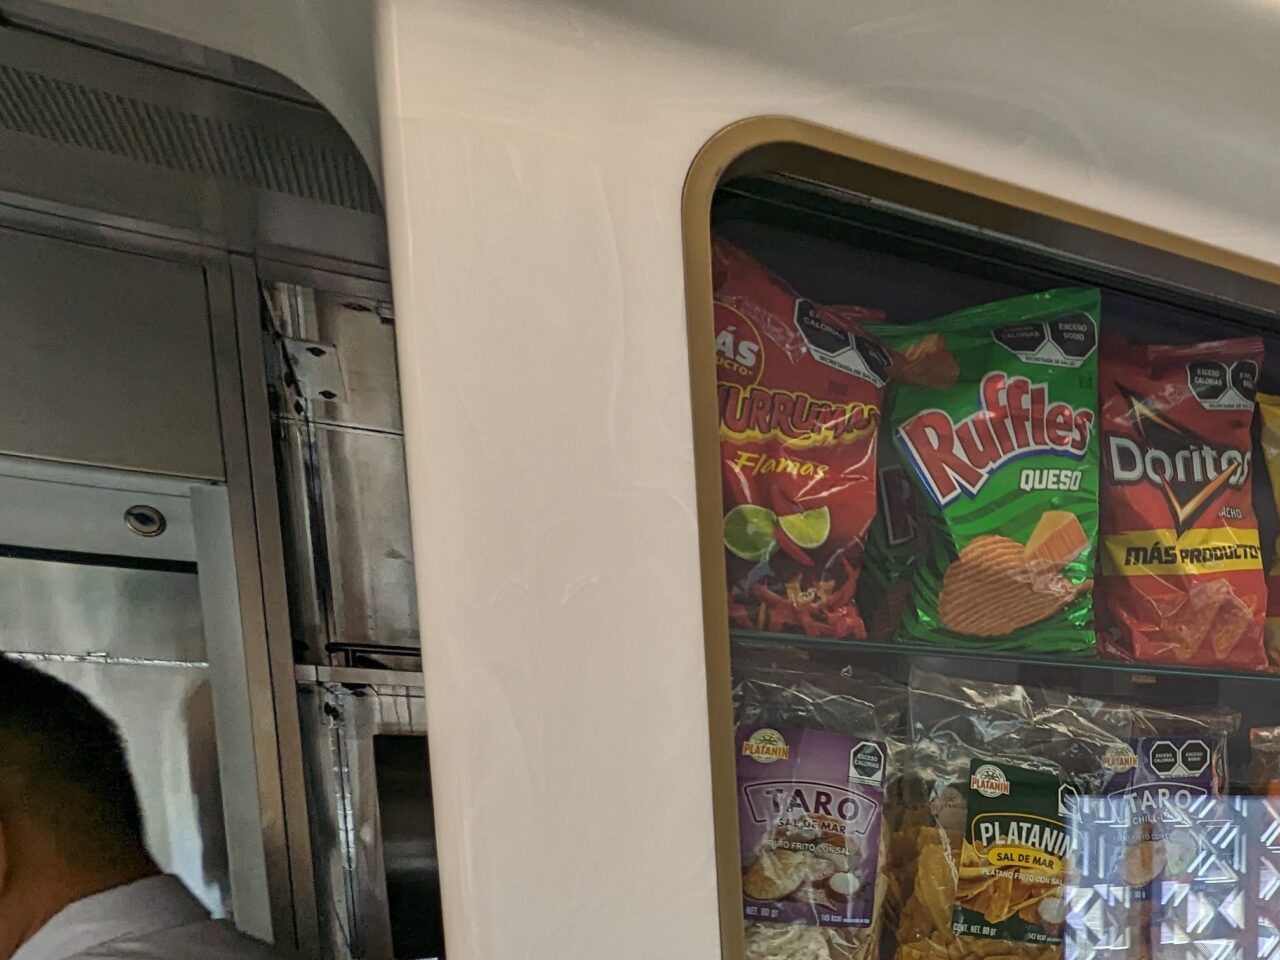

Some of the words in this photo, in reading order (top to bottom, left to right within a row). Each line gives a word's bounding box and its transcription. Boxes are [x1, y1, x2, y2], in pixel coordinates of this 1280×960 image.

[715, 326, 760, 366] ÁS
[897, 371, 1094, 507] Ruffles
[1020, 469, 1083, 491] QUESO
[1218, 507, 1242, 518] ACHO
[1124, 542, 1178, 566] MÁS
[971, 776, 1009, 793] PLATANIN
[765, 788, 860, 822] TARO
[821, 821, 847, 834] MAR
[996, 852, 1015, 862] SAL
[1018, 854, 1030, 863] DE
[1032, 857, 1054, 870] MAR
